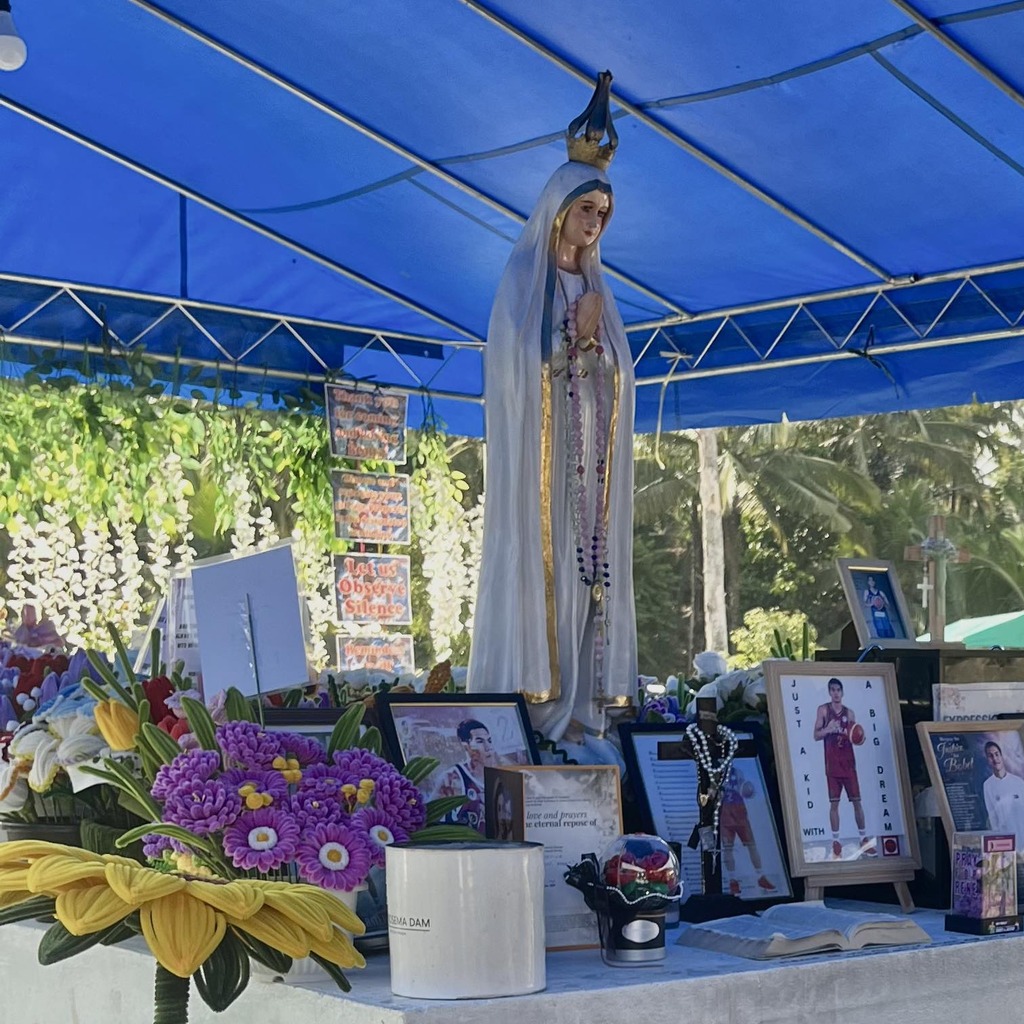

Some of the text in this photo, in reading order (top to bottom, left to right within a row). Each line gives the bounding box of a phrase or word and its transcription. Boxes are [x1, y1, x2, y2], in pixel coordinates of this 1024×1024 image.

[344, 557, 398, 577] Let us
[338, 578, 406, 597] Observe
[344, 598, 406, 616] Silence
[526, 811, 588, 822] love and prayers
[534, 820, 562, 828] eternal
[564, 820, 588, 828] repose
[803, 827, 825, 836] WITH
[409, 917, 430, 928] DAM
